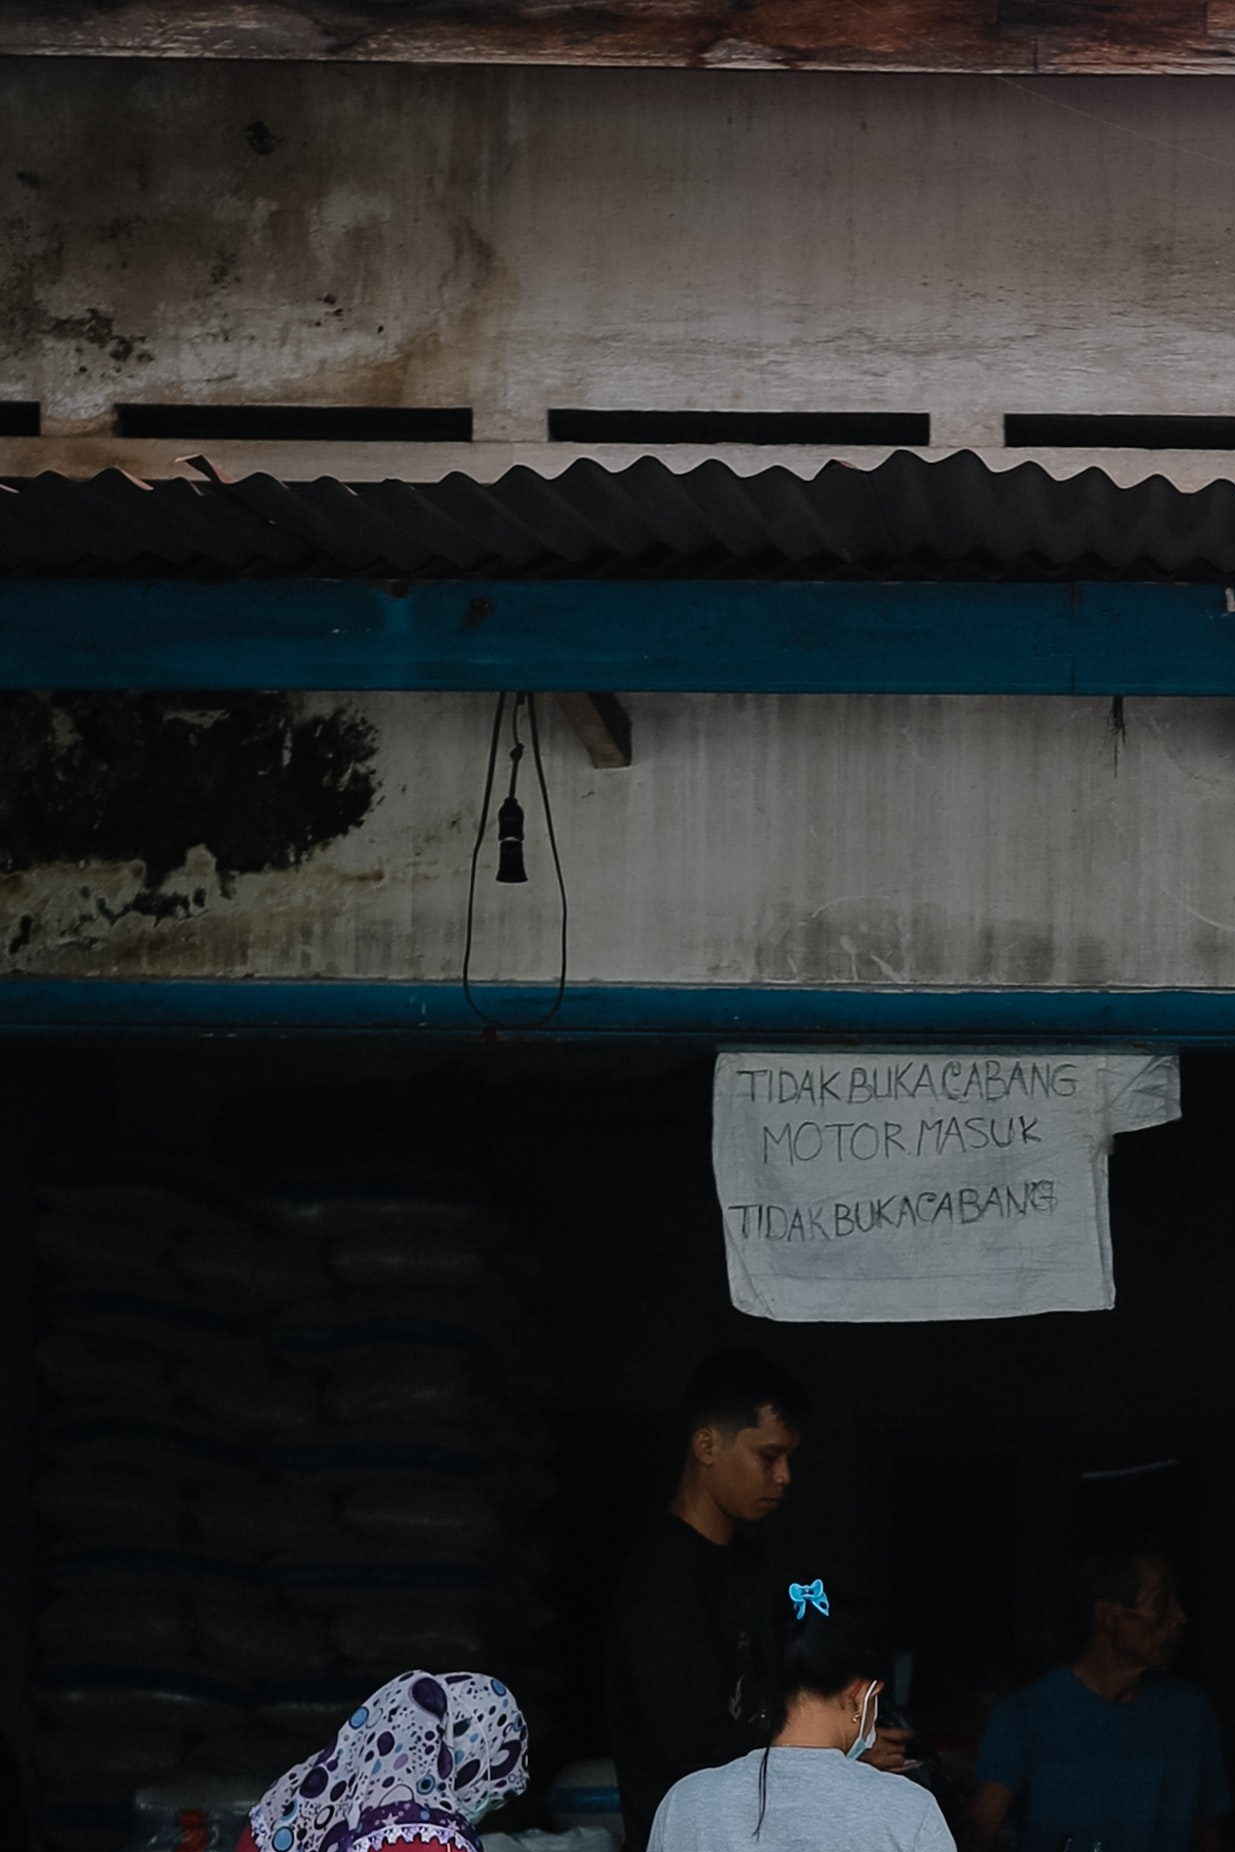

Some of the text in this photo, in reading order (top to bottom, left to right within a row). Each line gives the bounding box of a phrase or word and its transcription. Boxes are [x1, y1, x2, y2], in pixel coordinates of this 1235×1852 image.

[737, 1064, 841, 1107] TIDAK
[762, 1115, 1043, 1165] MOTOR MASUK
[728, 1203, 832, 1243] TIDAK
